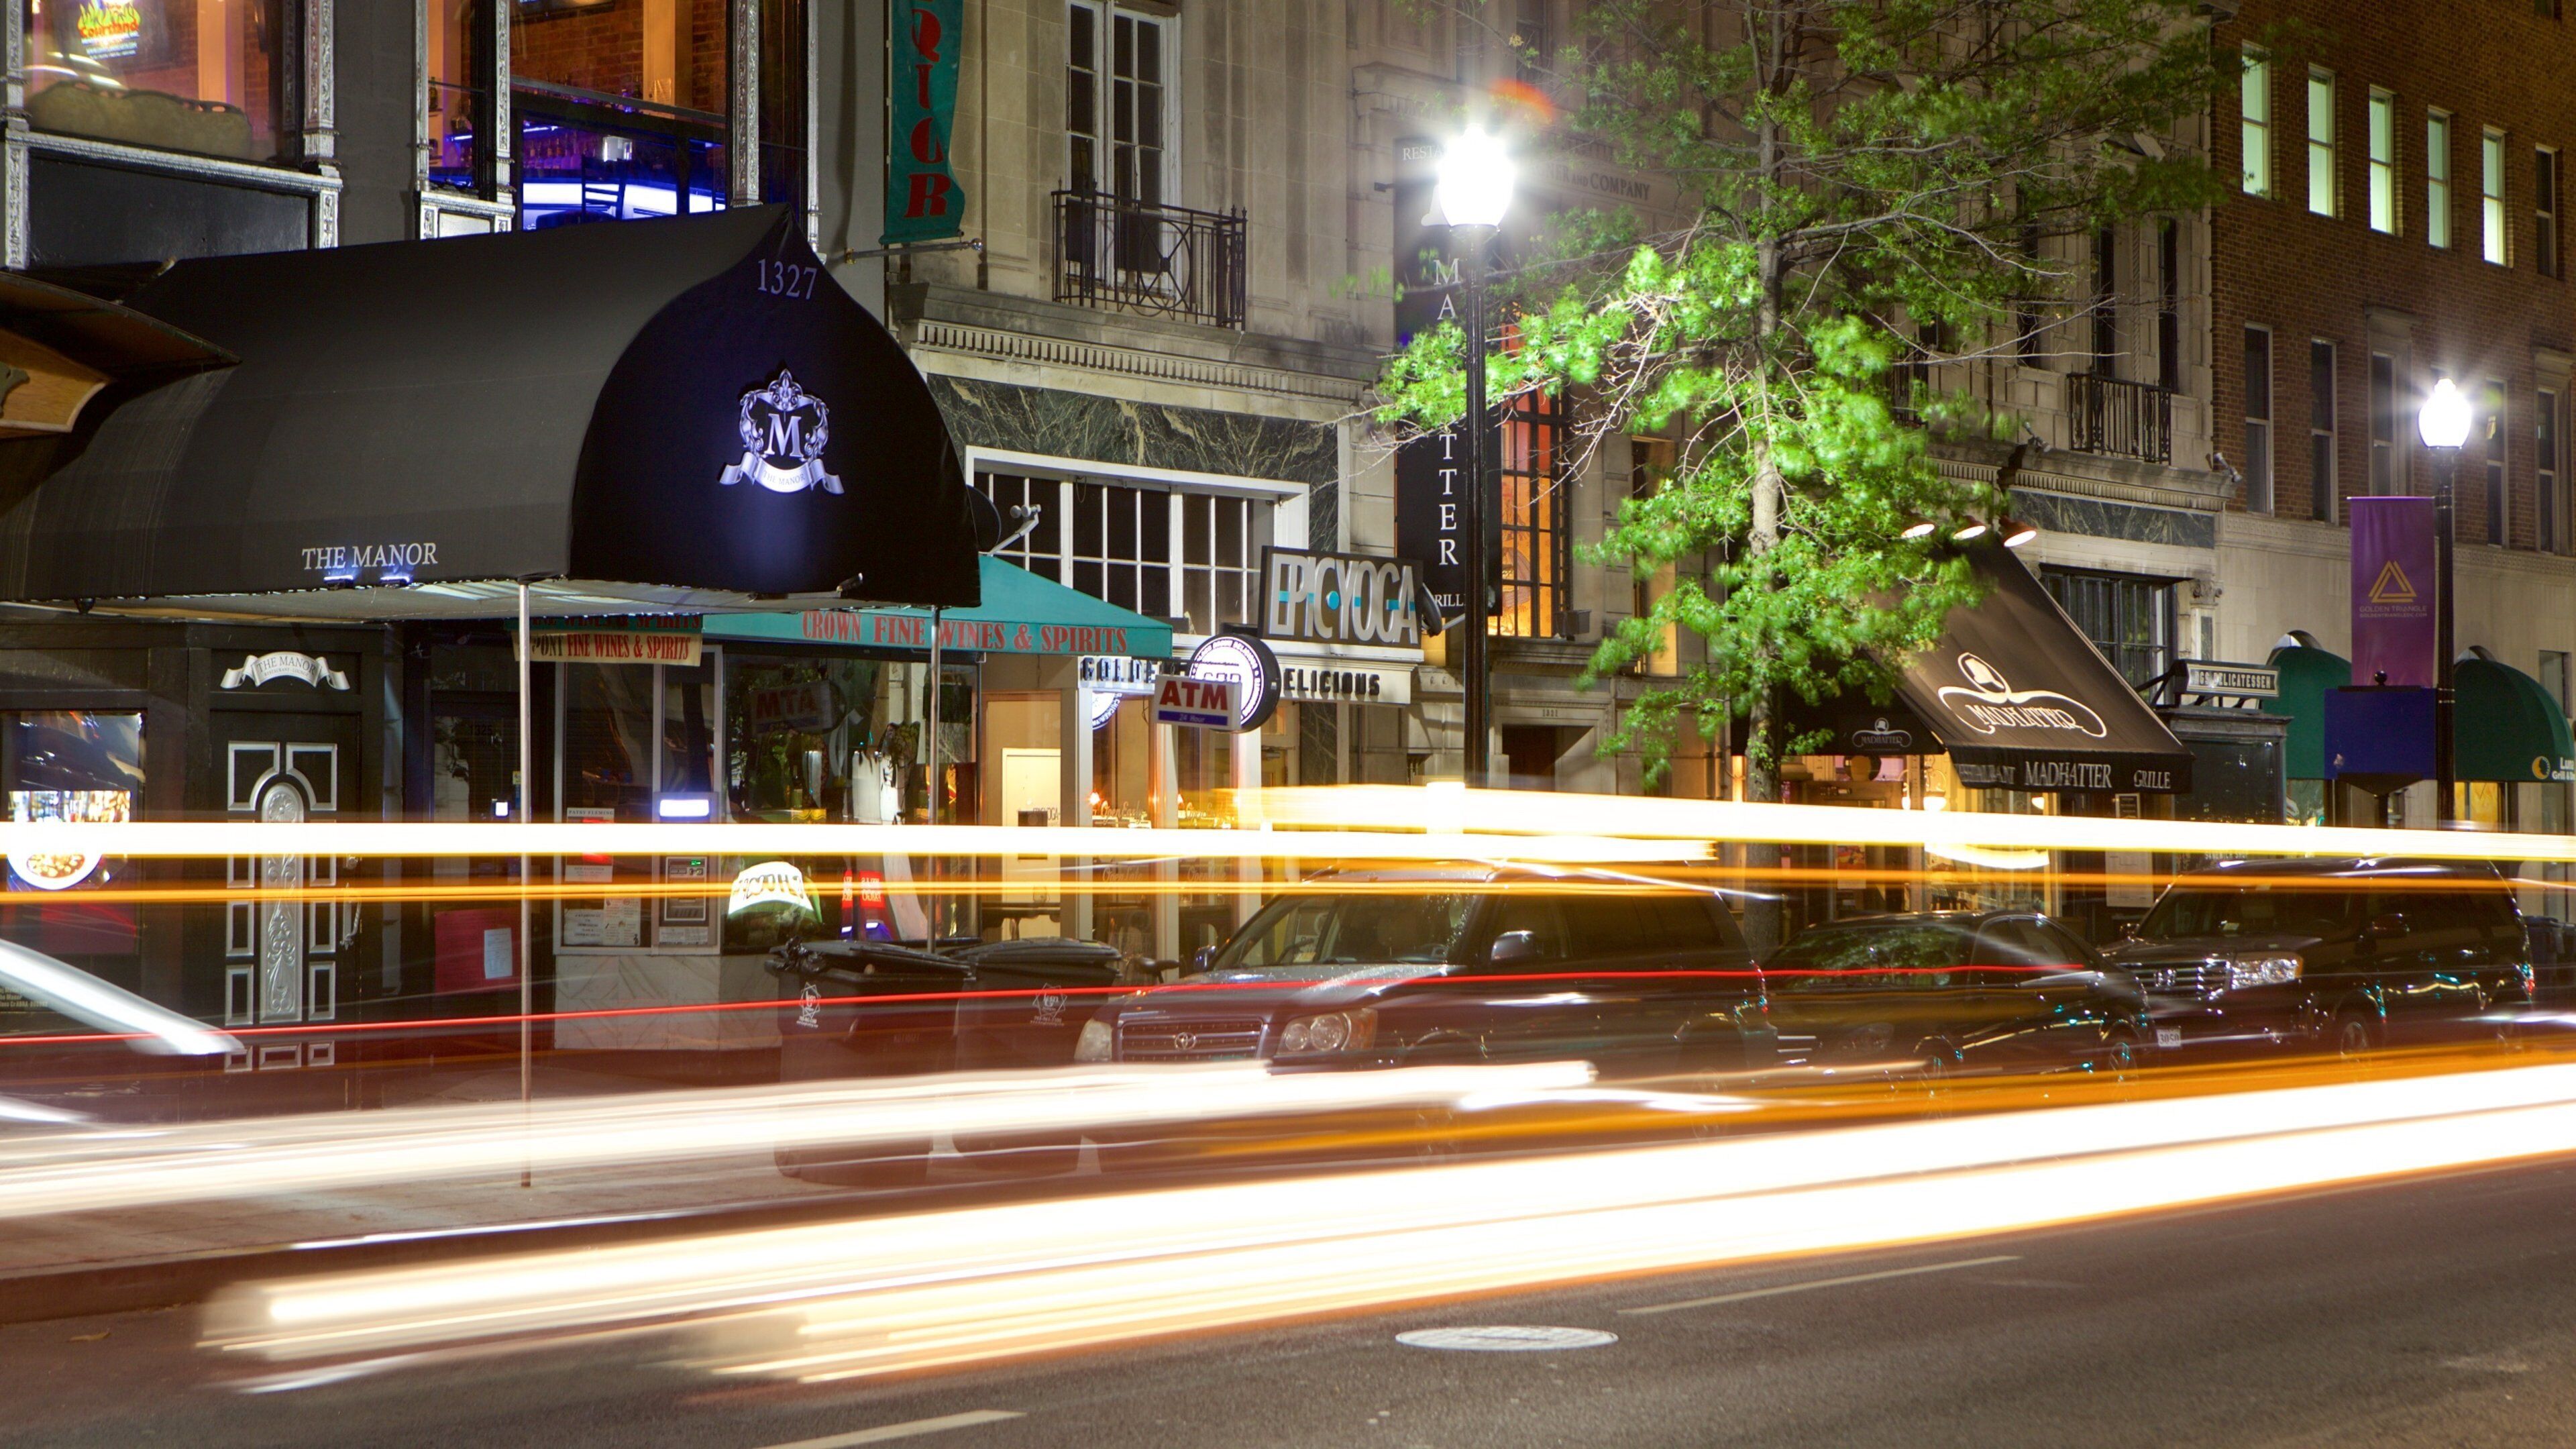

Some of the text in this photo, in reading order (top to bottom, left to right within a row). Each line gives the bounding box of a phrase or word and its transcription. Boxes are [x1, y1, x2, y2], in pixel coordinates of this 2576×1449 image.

[1590, 172, 1650, 201] COMPANY
[757, 258, 817, 300] 1327
[763, 413, 804, 458] M
[777, 473, 806, 486] MANOR
[302, 542, 438, 570] THE MANOR
[802, 610, 1128, 653] CROWN FINE WINES & SPIRITS
[566, 633, 590, 657] FINE
[594, 634, 630, 658] WINES
[633, 635, 643, 658] &
[646, 635, 691, 660] SPIRITS
[256, 655, 316, 676] THE MANOR
[1159, 680, 1228, 711] ATM
[1283, 667, 1381, 696] ELICIOUS
[2213, 672, 2271, 690] DELICATESSEN
[1965, 704, 2084, 731] MADHATTER
[2025, 761, 2112, 789] MADHATTER
[2133, 769, 2171, 790] GRILLE
